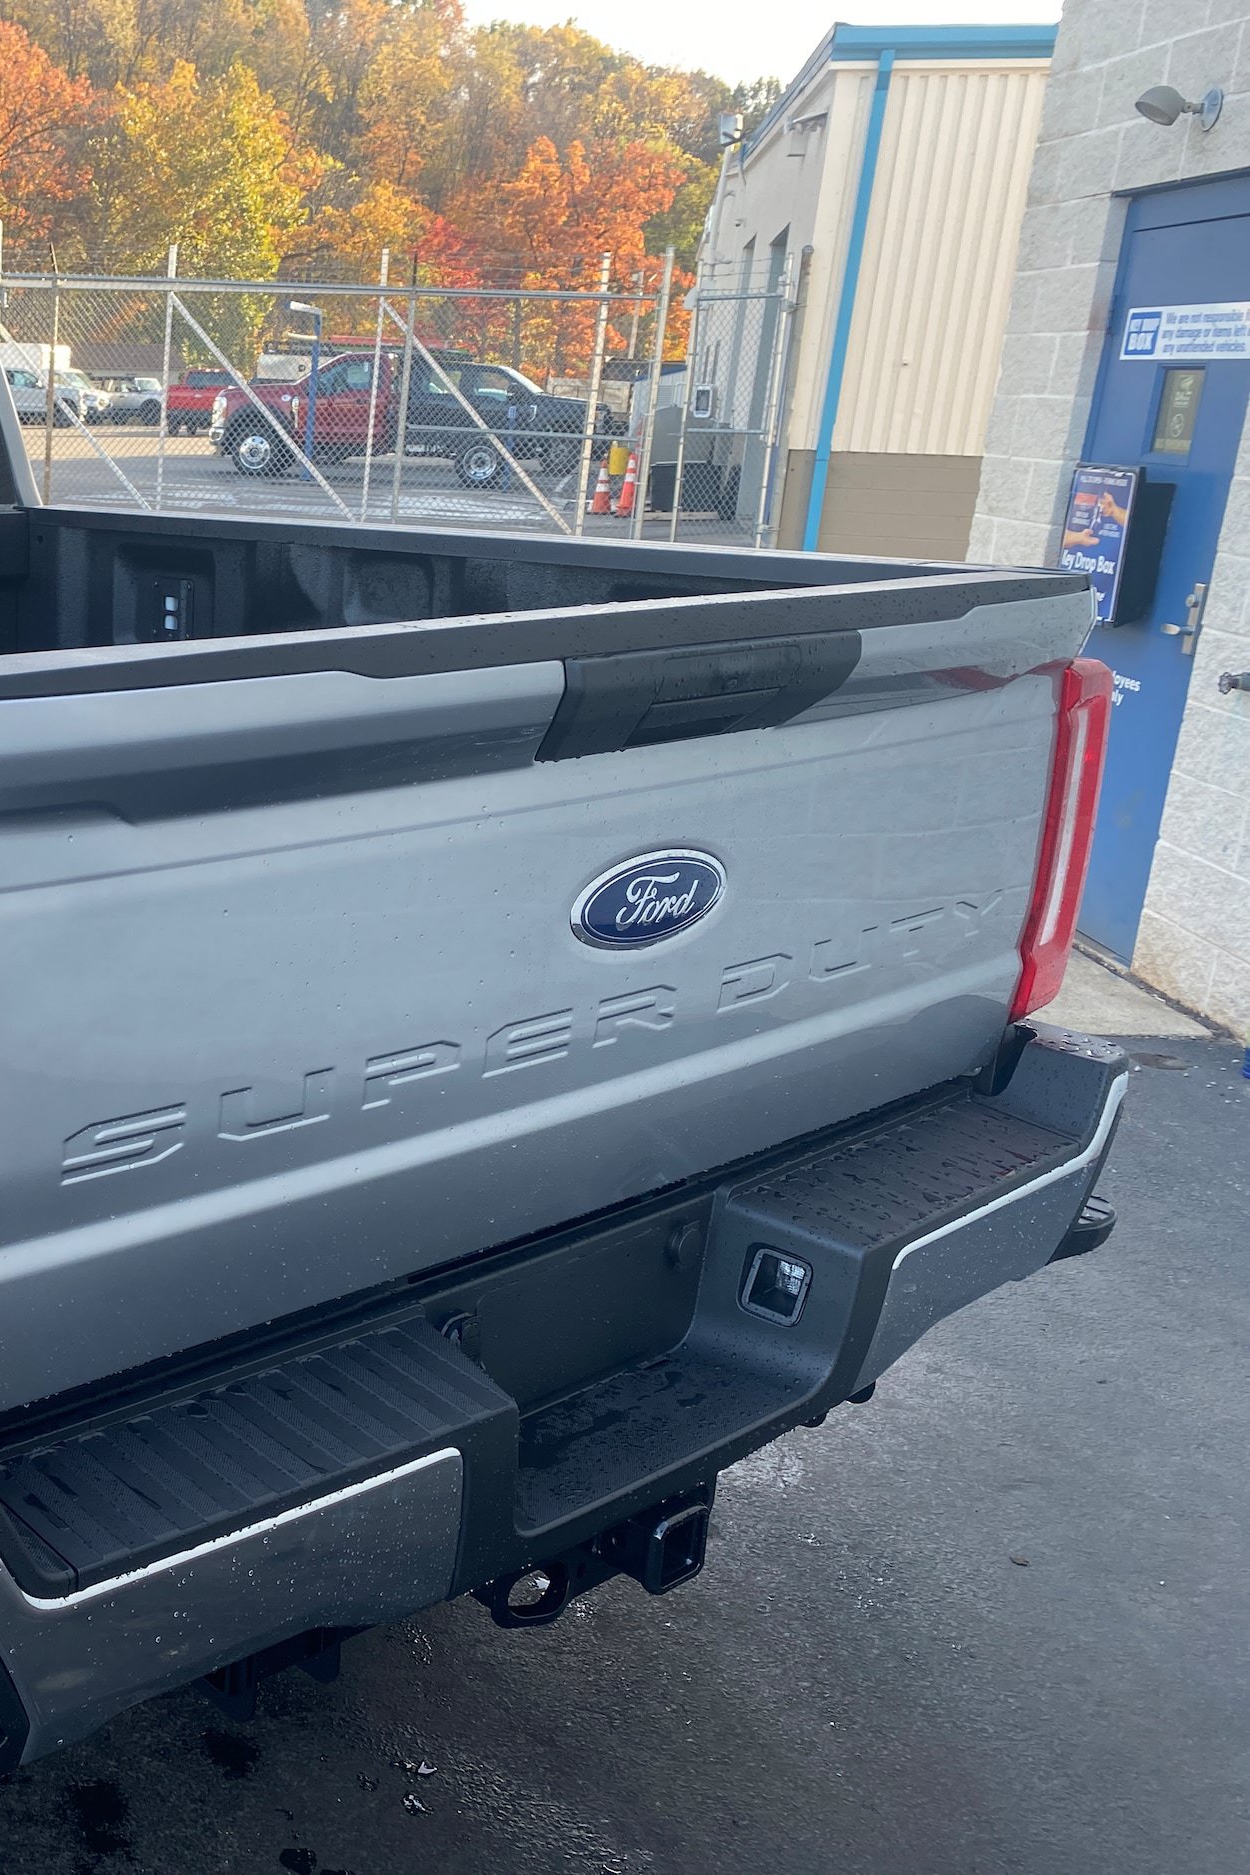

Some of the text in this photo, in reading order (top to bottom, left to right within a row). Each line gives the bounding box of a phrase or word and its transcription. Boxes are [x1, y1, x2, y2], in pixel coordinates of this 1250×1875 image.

[1128, 333, 1155, 350] BOX
[1075, 552, 1097, 573] Drop
[1097, 555, 1116, 575] Box
[615, 871, 700, 926] Ford
[61, 890, 1005, 1186] SUPER DUTY
